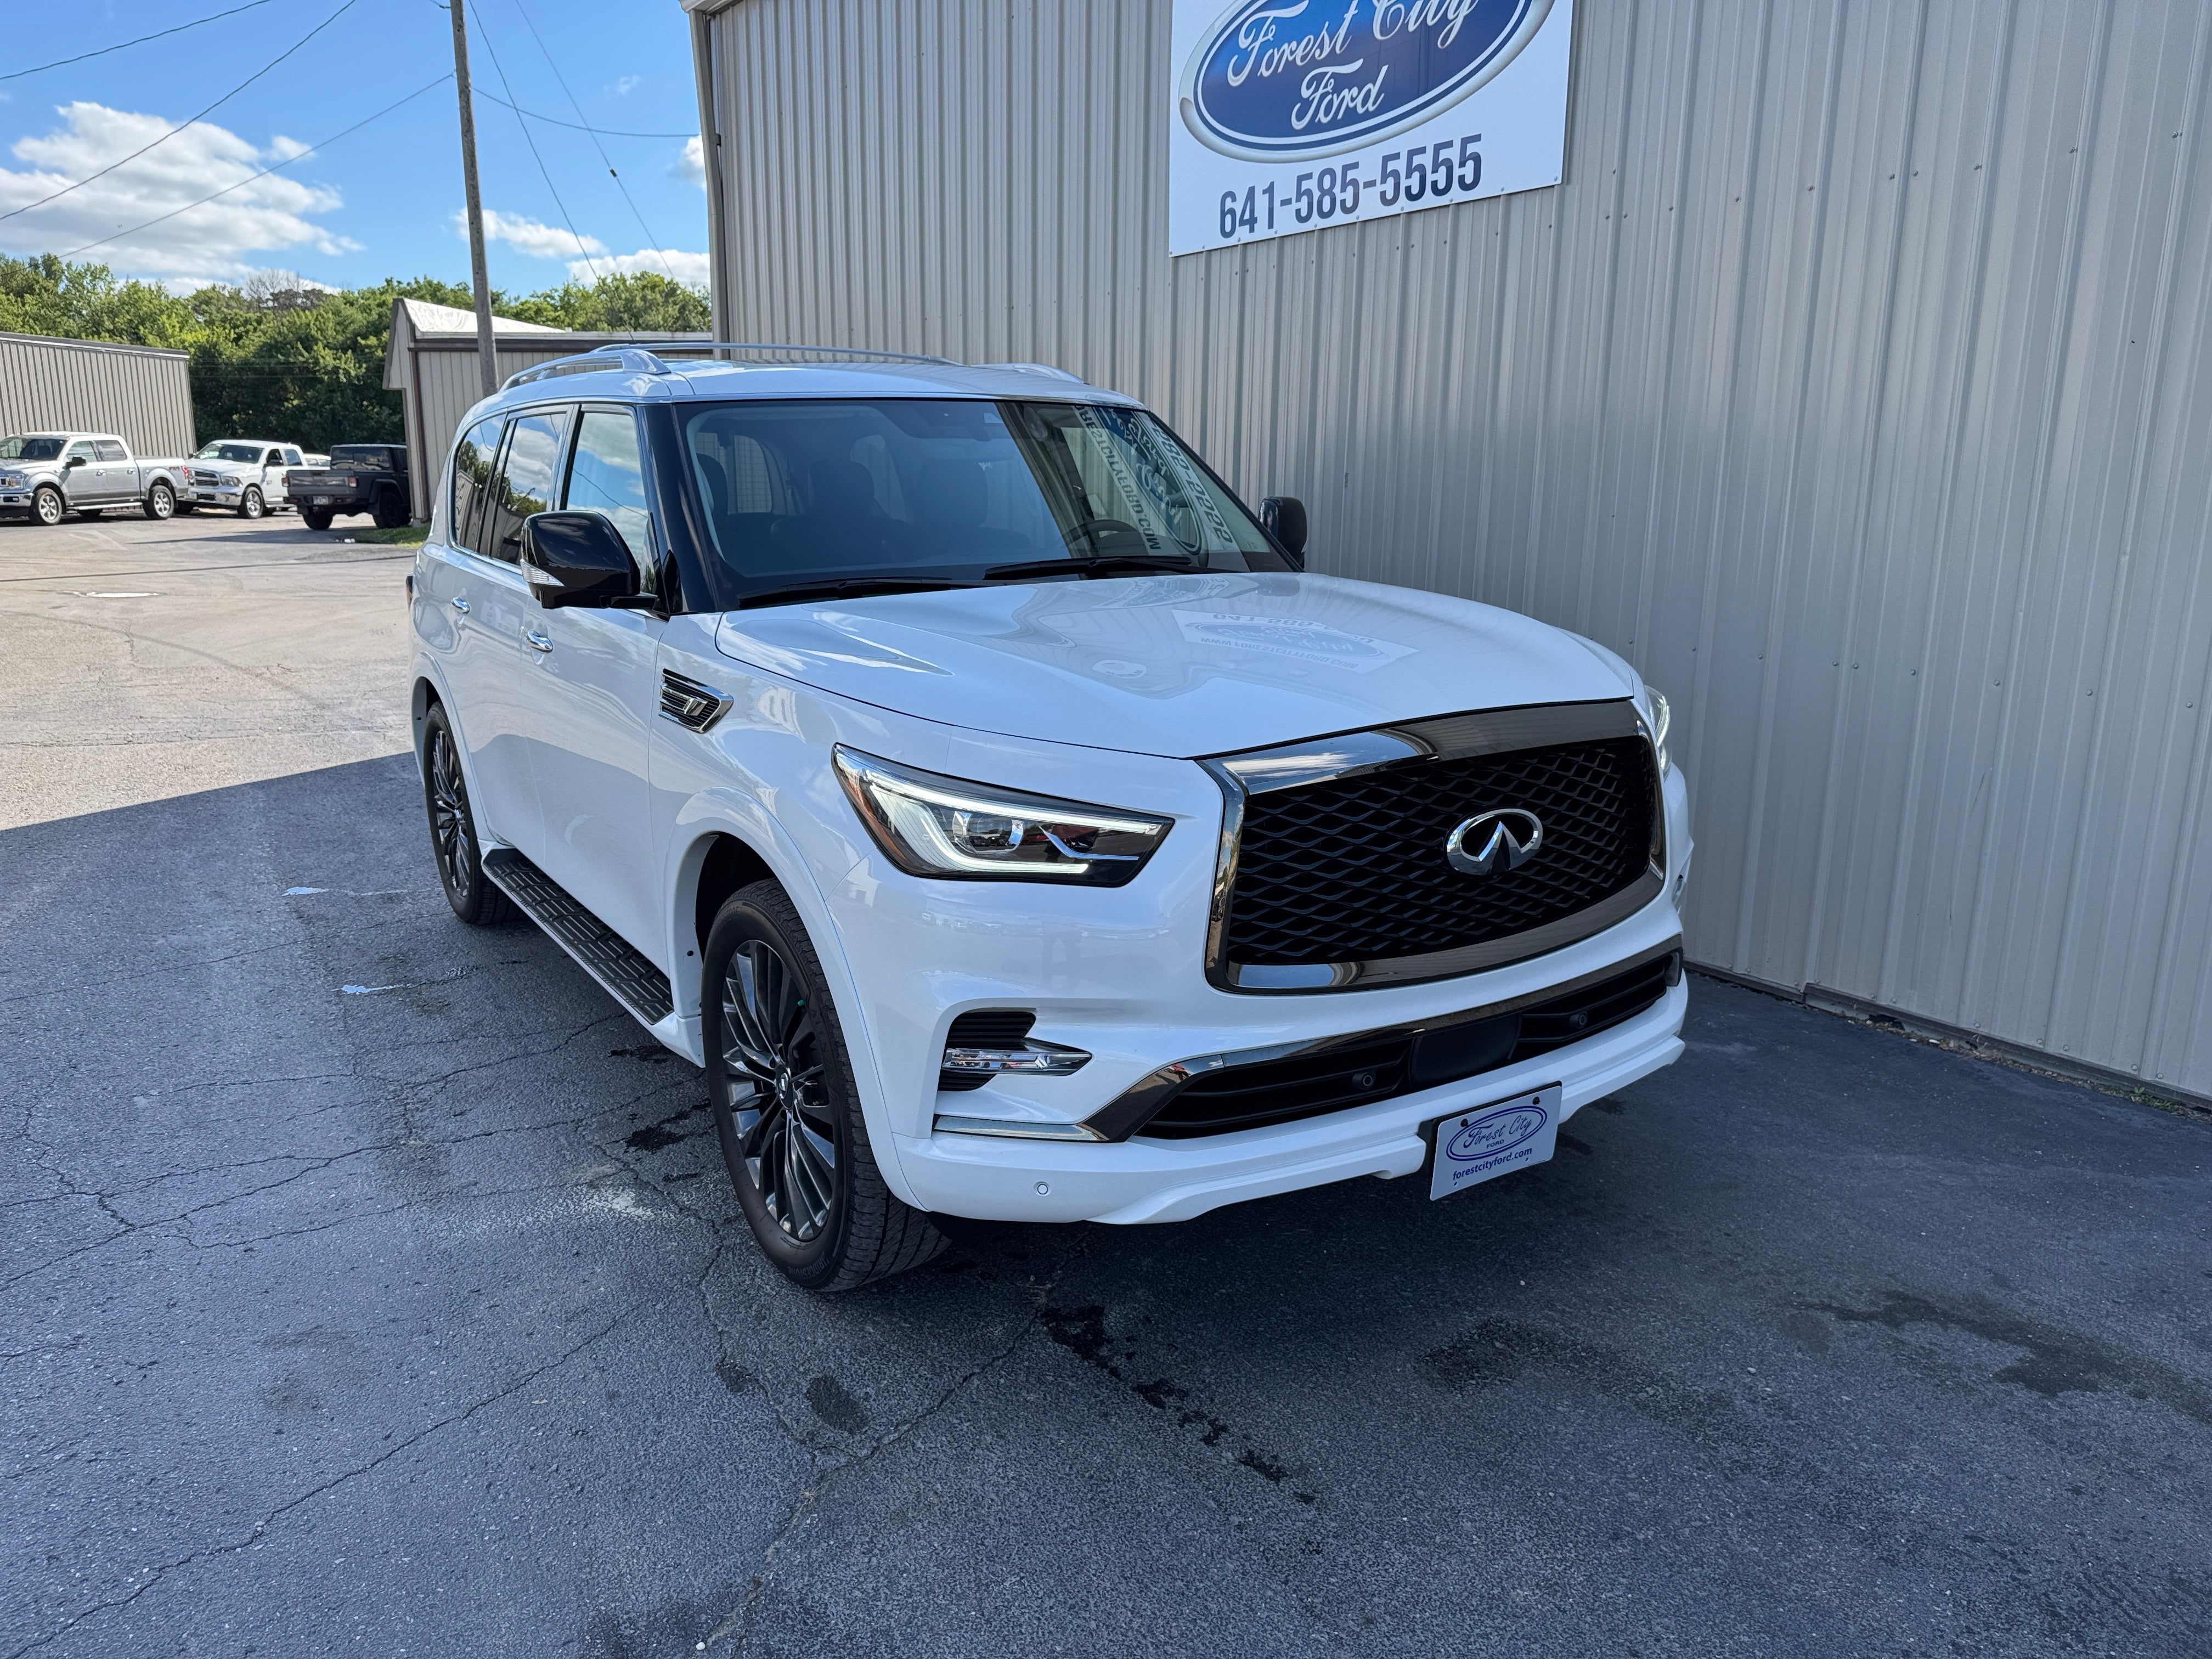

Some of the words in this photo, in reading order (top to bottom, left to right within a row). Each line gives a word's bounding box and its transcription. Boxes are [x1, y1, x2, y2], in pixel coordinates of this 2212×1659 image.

[1227, 0, 1363, 87] Forest
[1291, 59, 1389, 130] Ford
[1219, 133, 1482, 239] 641-585-5555
[1463, 1123, 1506, 1148] Forest
[1509, 1115, 1532, 1137] City
[1486, 1139, 1504, 1149] FORD
[1453, 1147, 1532, 1180] forestcityford.com
